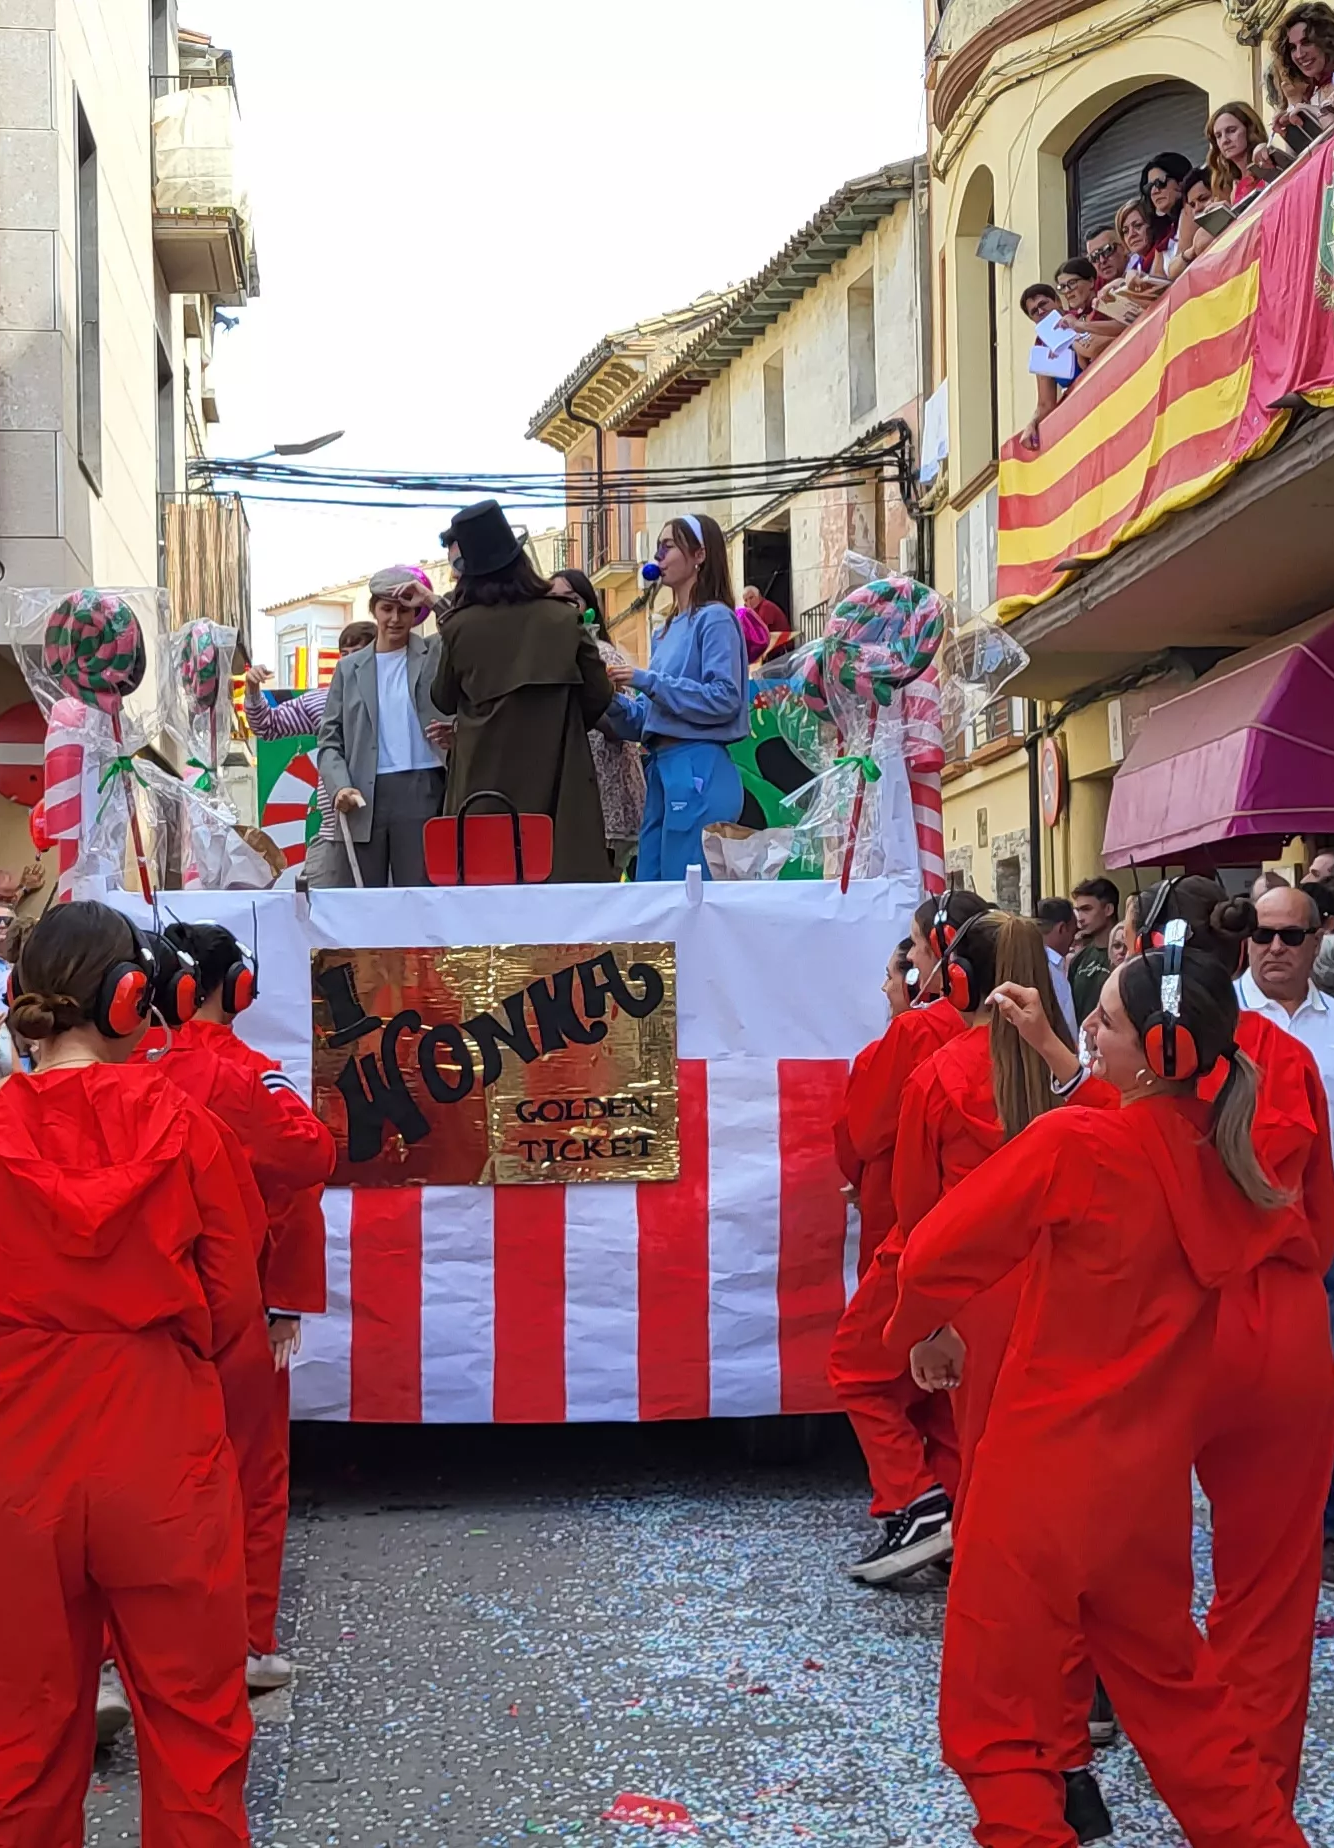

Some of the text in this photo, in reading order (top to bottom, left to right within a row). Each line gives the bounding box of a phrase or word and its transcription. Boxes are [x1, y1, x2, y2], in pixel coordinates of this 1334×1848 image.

[335, 950, 665, 1162] WONKA
[515, 1095, 655, 1124] GOLDEN
[518, 1133, 653, 1163] TICKET
